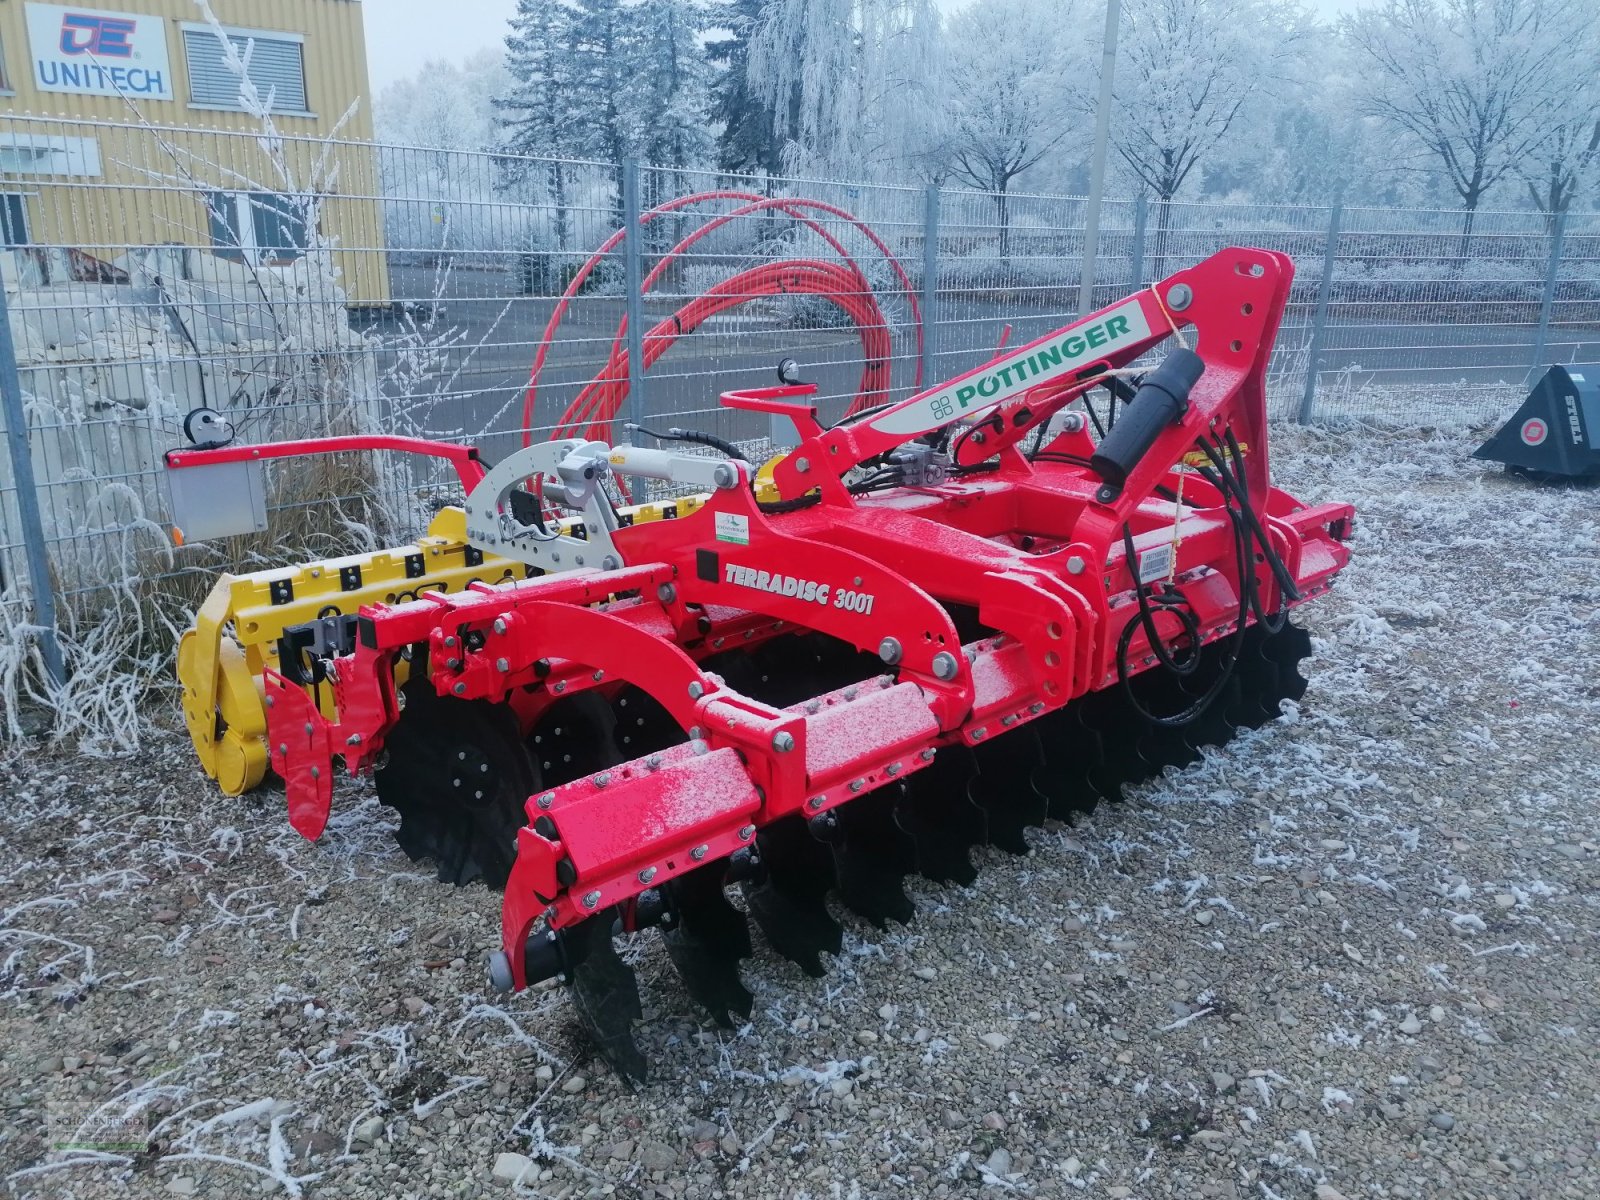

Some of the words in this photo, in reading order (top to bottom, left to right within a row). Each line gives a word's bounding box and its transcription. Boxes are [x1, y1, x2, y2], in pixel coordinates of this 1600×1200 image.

[38, 60, 163, 94] UNITECH
[955, 314, 1132, 408] PÖTTINGER
[1564, 395, 1583, 445] STOLL
[725, 563, 830, 605] TERRADISC
[833, 588, 874, 615] 3001
